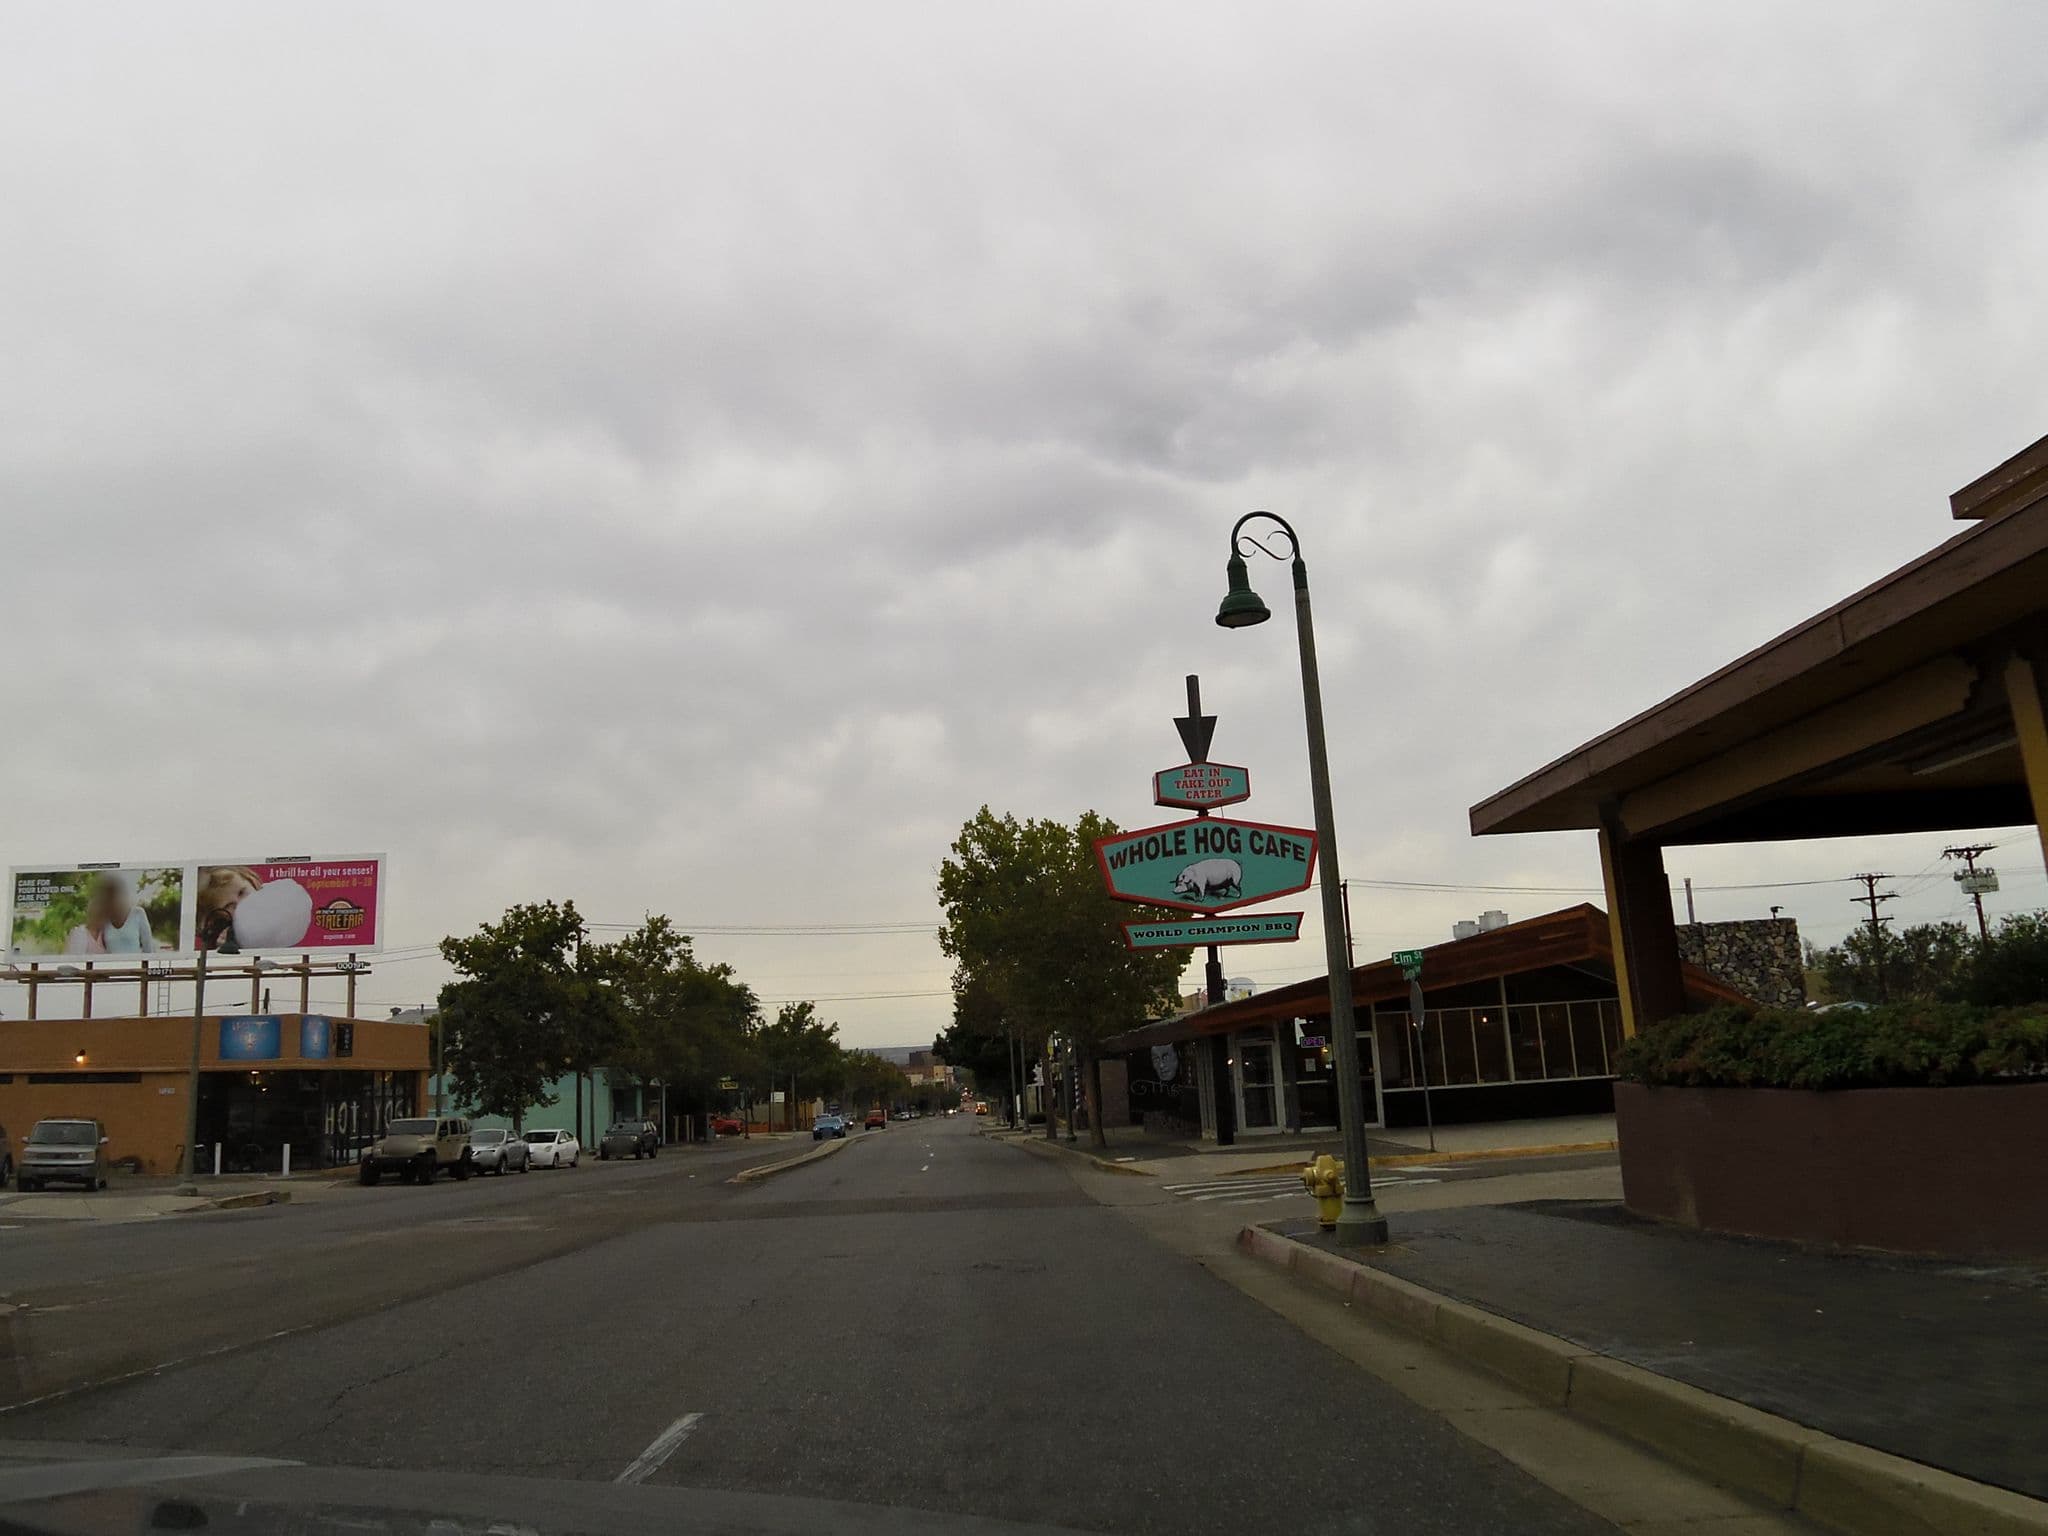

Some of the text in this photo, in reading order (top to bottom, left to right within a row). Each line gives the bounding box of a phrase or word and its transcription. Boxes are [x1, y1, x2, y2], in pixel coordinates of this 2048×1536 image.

[1184, 767, 1220, 778] EAT IN
[1174, 778, 1231, 789] TAKE OUT
[1186, 789, 1222, 799] CATER
[1109, 826, 1306, 870] WHOLE HOG CAFE
[269, 867, 275, 878] A
[276, 867, 296, 877] thrill
[297, 867, 309, 877] for
[323, 867, 341, 878] your
[315, 913, 364, 930] STATE FAIR
[1133, 922, 1293, 939] WORLD CHAMPION BBQ
[1392, 950, 1423, 965] Elm St
